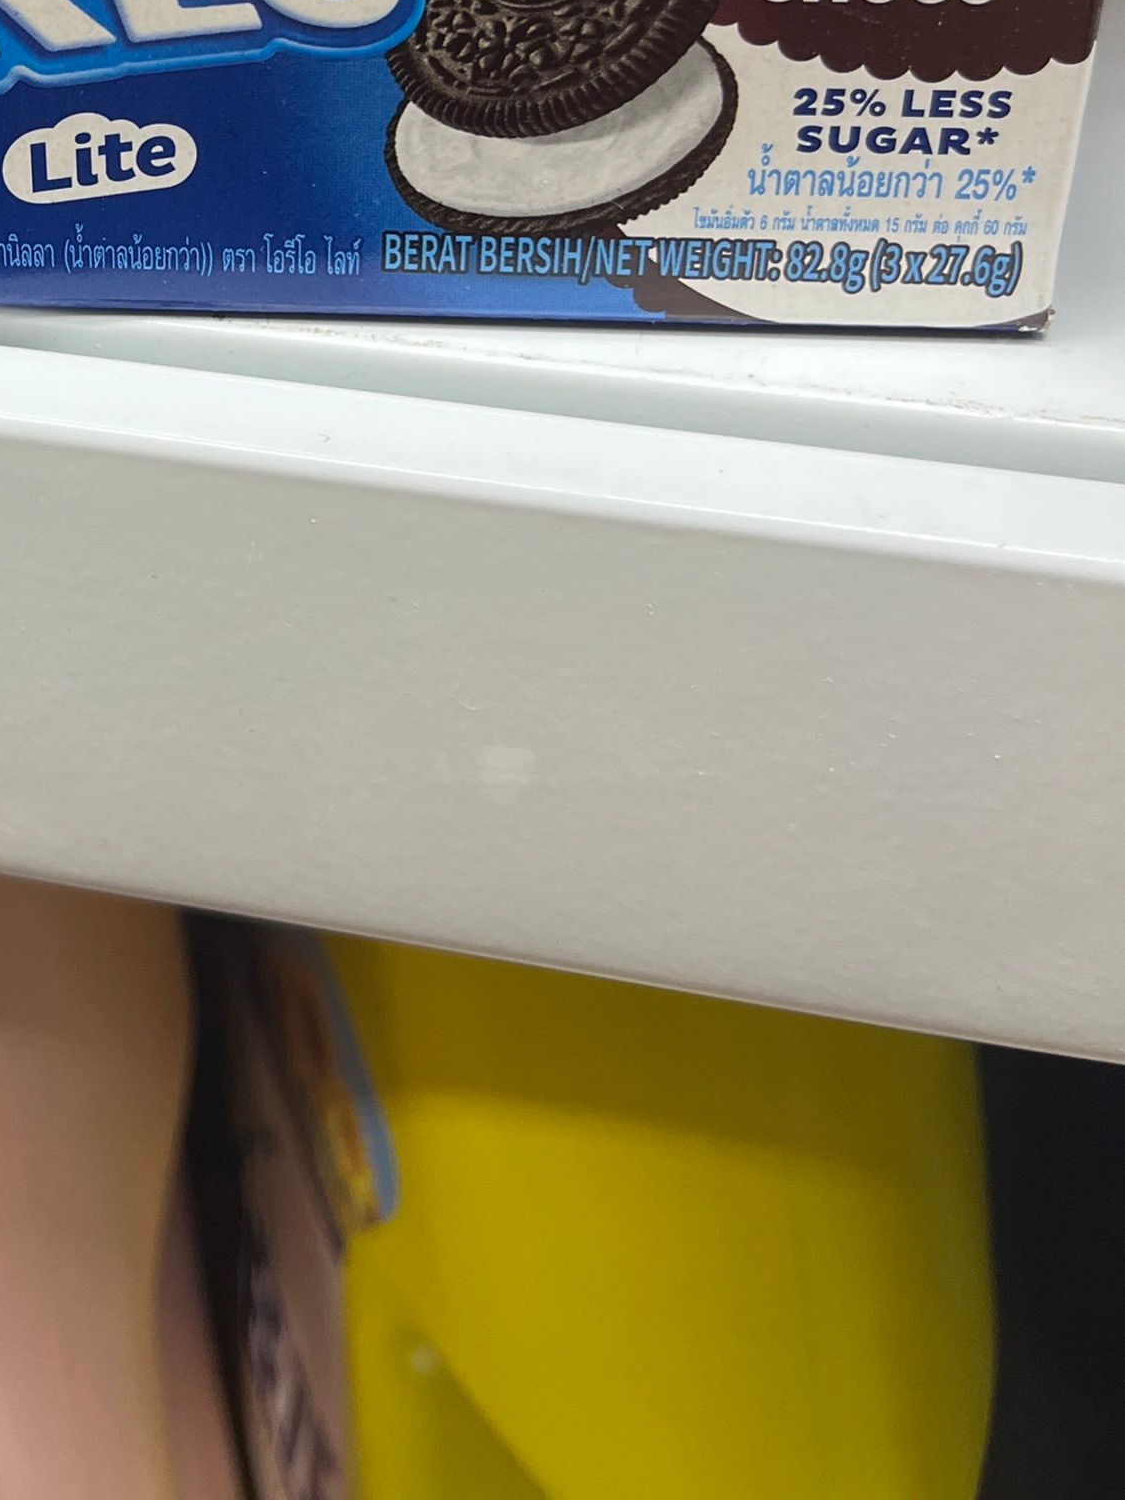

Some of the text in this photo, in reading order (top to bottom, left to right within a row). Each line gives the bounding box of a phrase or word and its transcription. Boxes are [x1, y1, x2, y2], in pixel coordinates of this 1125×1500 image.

[791, 88, 1012, 119] 25% LESS
[28, 129, 178, 194] Lite
[747, 141, 943, 199] น้ำตาลน้อยกว่า
[759, 214, 768, 230] 6
[885, 217, 900, 233] 15
[983, 219, 999, 235] 60
[221, 245, 256, 273] ตรา
[383, 232, 475, 274] BERAT
[479, 234, 651, 279] BERSIH/NET
[656, 238, 783, 281] WEIGHT:
[784, 241, 869, 294] 82.8g
[870, 238, 903, 292] (3
[926, 241, 1024, 297] 27.6g)
